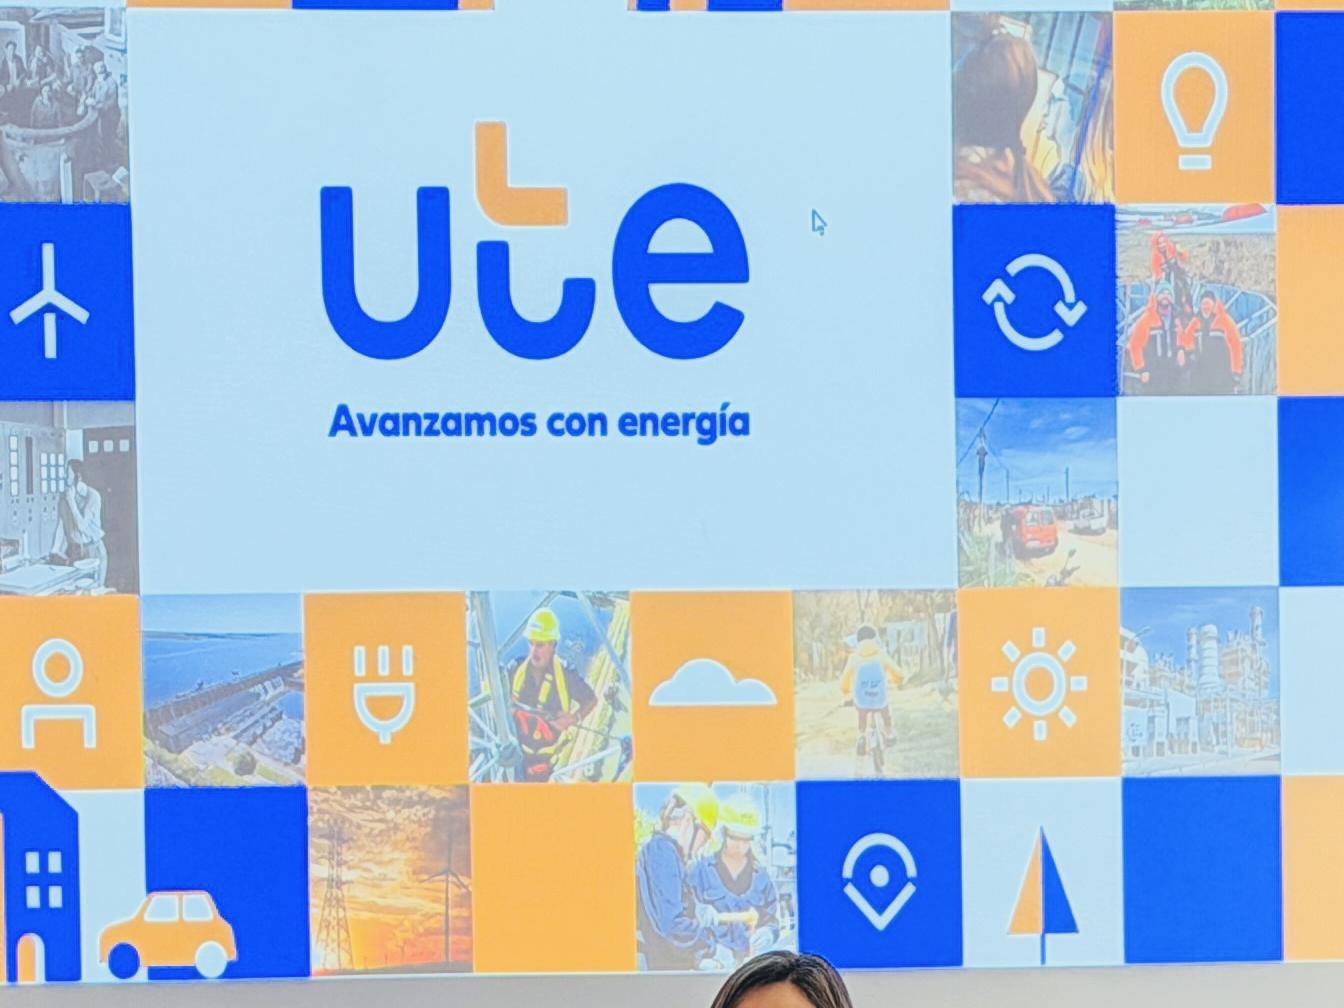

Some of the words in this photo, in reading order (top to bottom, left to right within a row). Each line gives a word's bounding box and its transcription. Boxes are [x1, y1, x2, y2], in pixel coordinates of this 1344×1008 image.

[320, 121, 749, 359] ute
[328, 404, 537, 437] Avanzamos
[547, 411, 607, 437] con
[618, 402, 750, 446] energía
